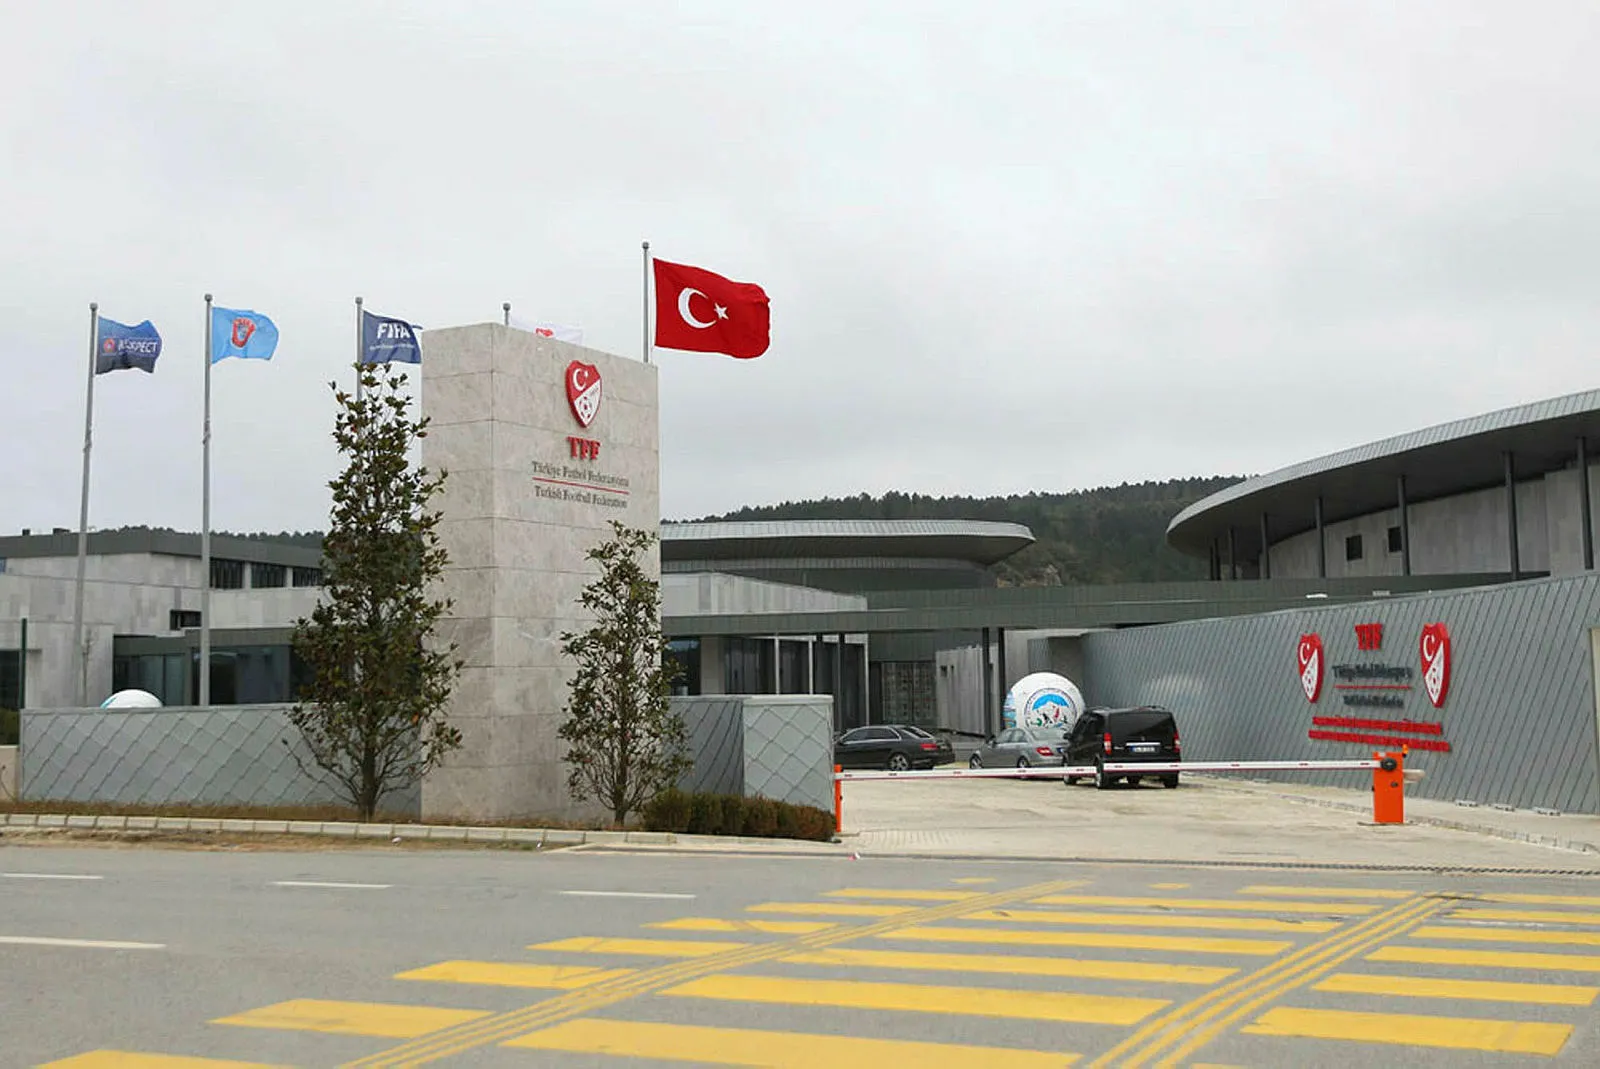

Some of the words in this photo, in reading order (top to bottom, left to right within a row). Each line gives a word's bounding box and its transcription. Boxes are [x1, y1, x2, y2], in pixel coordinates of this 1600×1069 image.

[377, 322, 411, 339] FIFA
[566, 436, 600, 460] TFF
[535, 485, 562, 500] Turkish
[563, 489, 591, 503] Football
